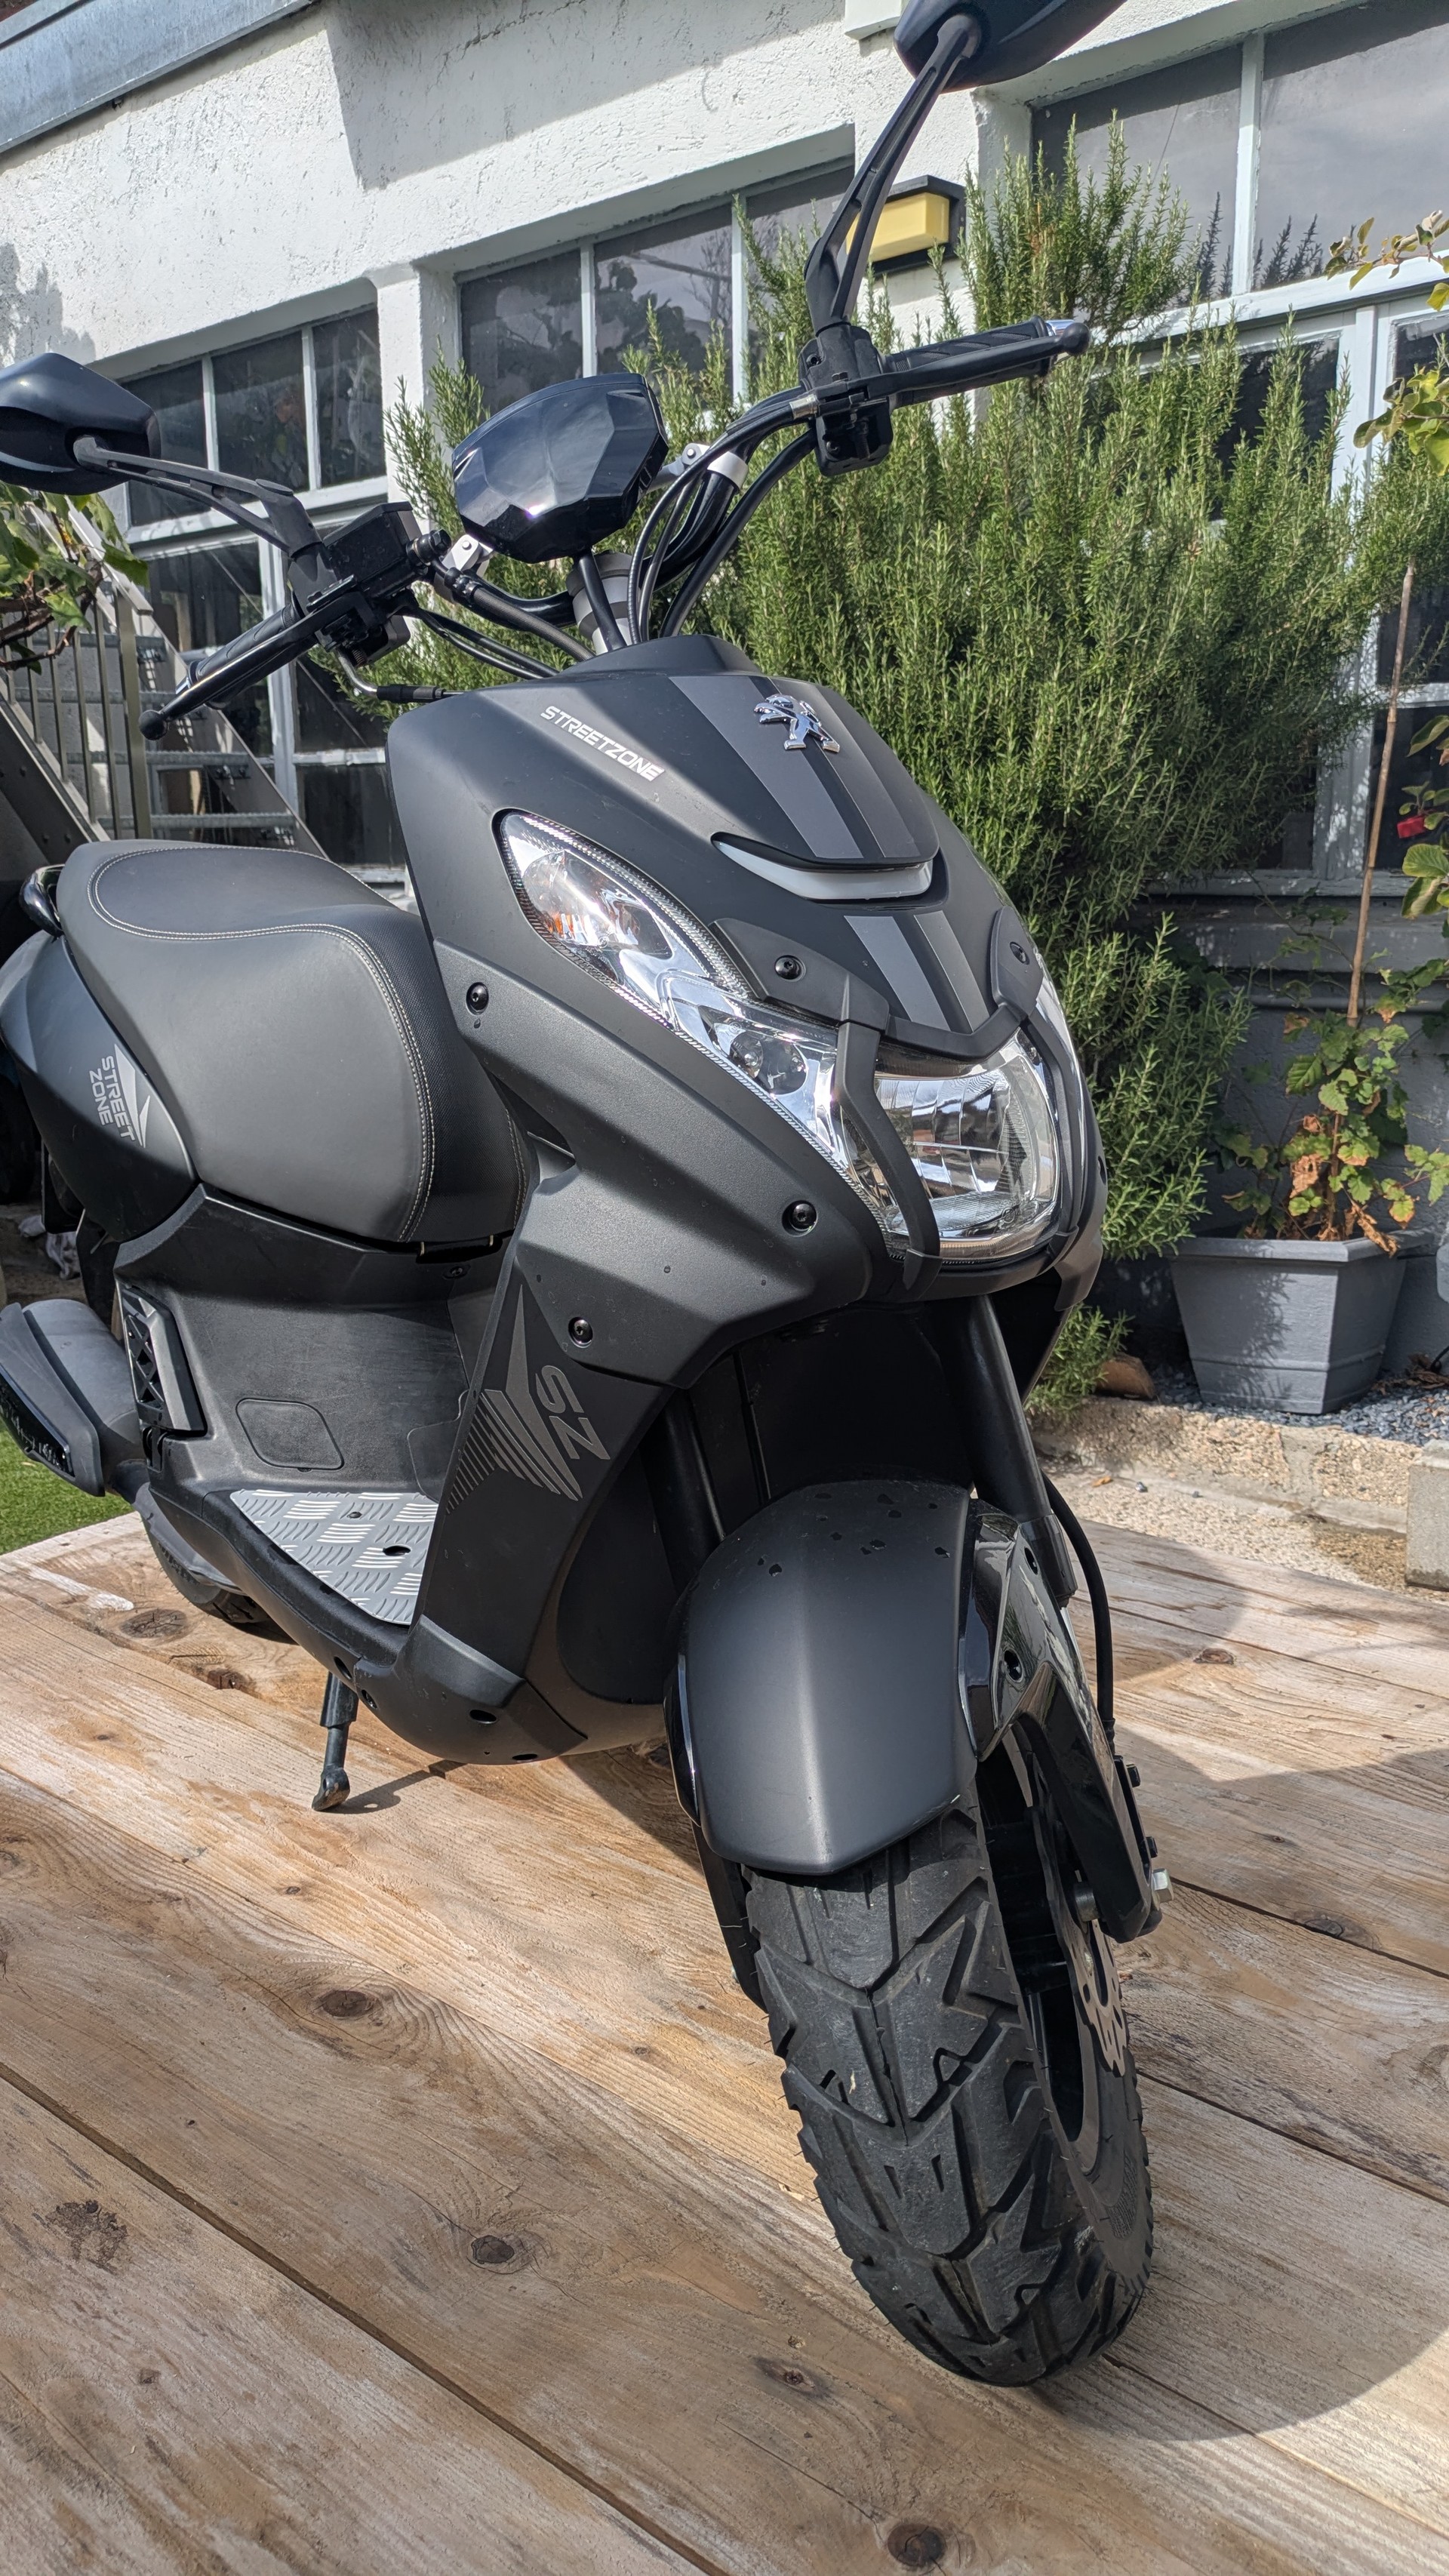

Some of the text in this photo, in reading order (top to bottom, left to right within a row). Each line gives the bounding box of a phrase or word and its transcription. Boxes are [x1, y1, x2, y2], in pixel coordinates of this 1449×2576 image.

[540, 706, 666, 781] STREETZONE
[89, 1068, 113, 1125] ZONE
[101, 1055, 135, 1141] STREET
[535, 1365, 611, 1460] SZ
